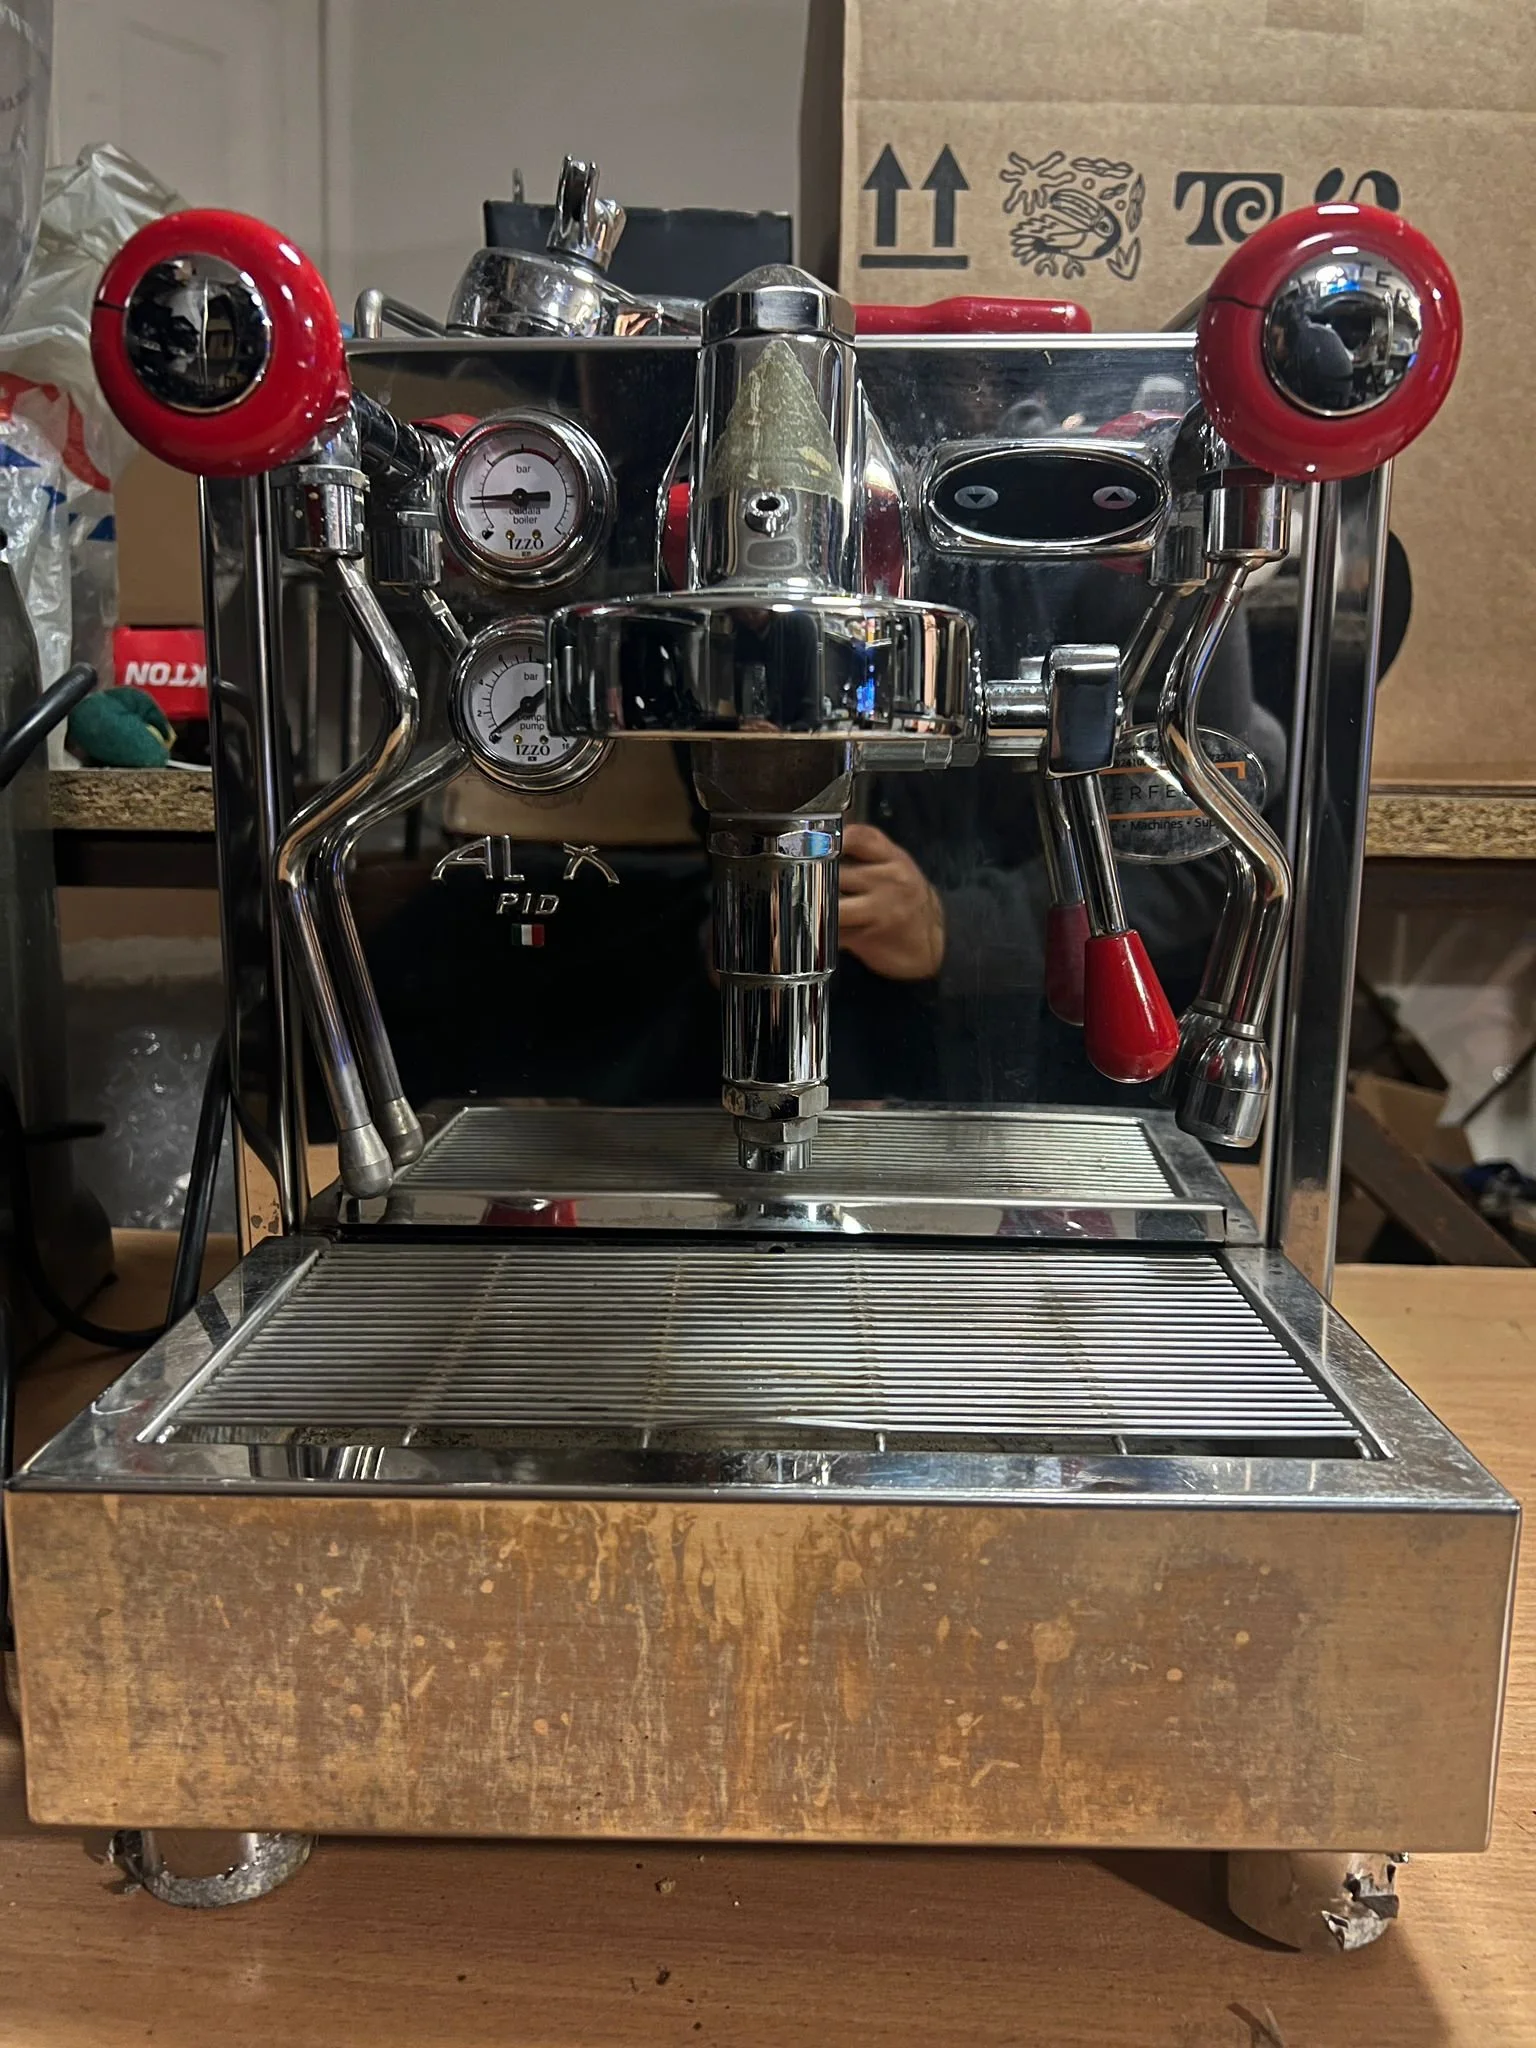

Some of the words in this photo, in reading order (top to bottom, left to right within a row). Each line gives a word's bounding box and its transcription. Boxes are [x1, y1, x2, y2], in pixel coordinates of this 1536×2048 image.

[516, 465, 531, 474] bar
[513, 515, 538, 525] boiler
[509, 538, 544, 550] IZZO
[124, 661, 207, 688] KTON
[523, 672, 539, 681] bar
[477, 709, 482, 717] 2
[520, 723, 545, 732] pump
[516, 745, 550, 756] IZZO
[1103, 785, 1189, 800] ERFE
[1130, 819, 1183, 831] Machines
[1194, 818, 1217, 830] Sup
[496, 892, 560, 915] PID
